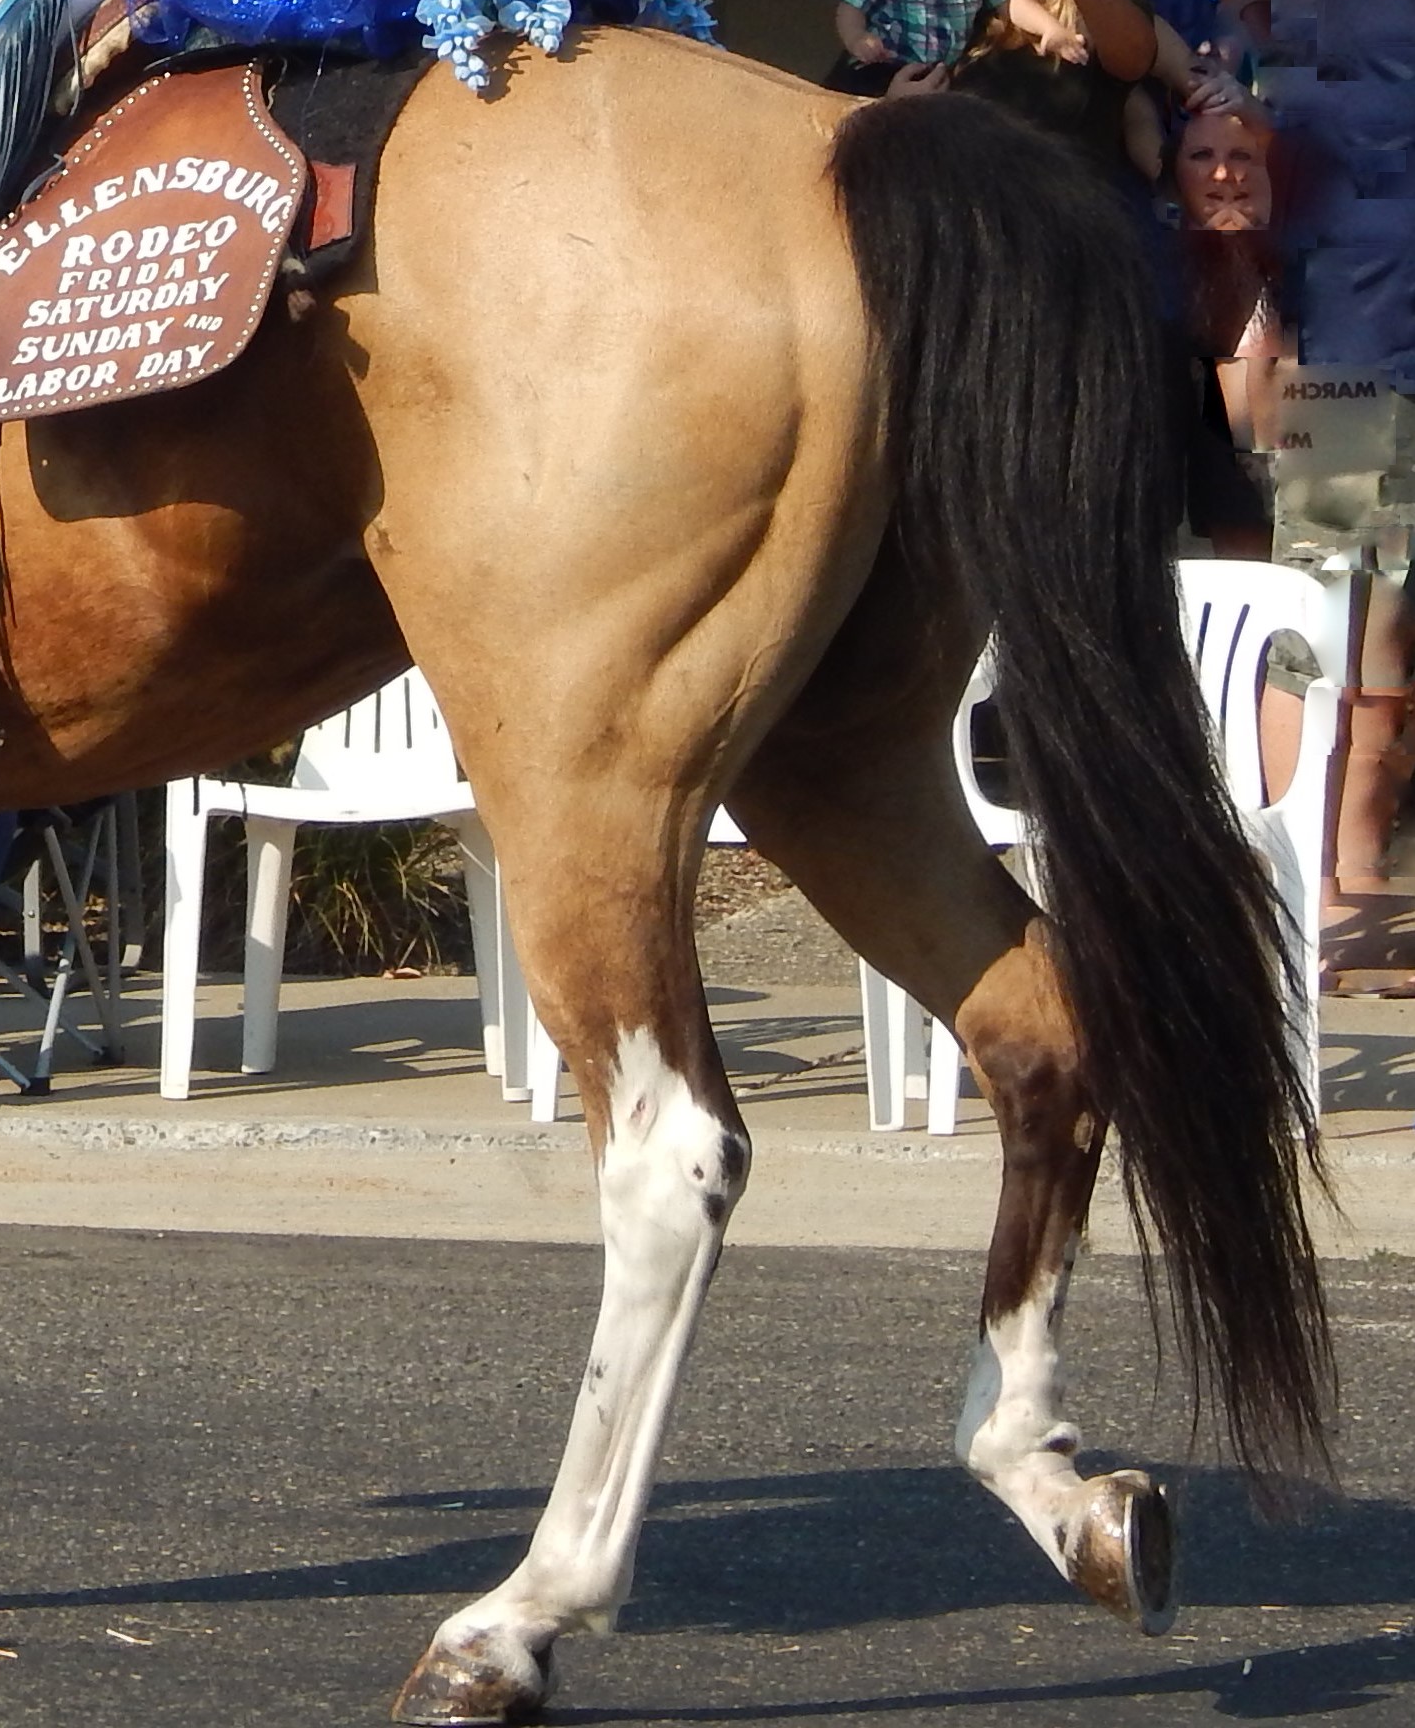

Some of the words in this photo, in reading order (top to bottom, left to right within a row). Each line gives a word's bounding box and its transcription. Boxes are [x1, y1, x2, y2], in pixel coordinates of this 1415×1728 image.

[61, 215, 237, 269] RODEO
[58, 250, 218, 294] FRIDAY
[22, 273, 230, 329] SATURDAY
[11, 317, 175, 366] SUNDAY
[183, 314, 224, 332] AND
[136, 341, 215, 379] DAY
